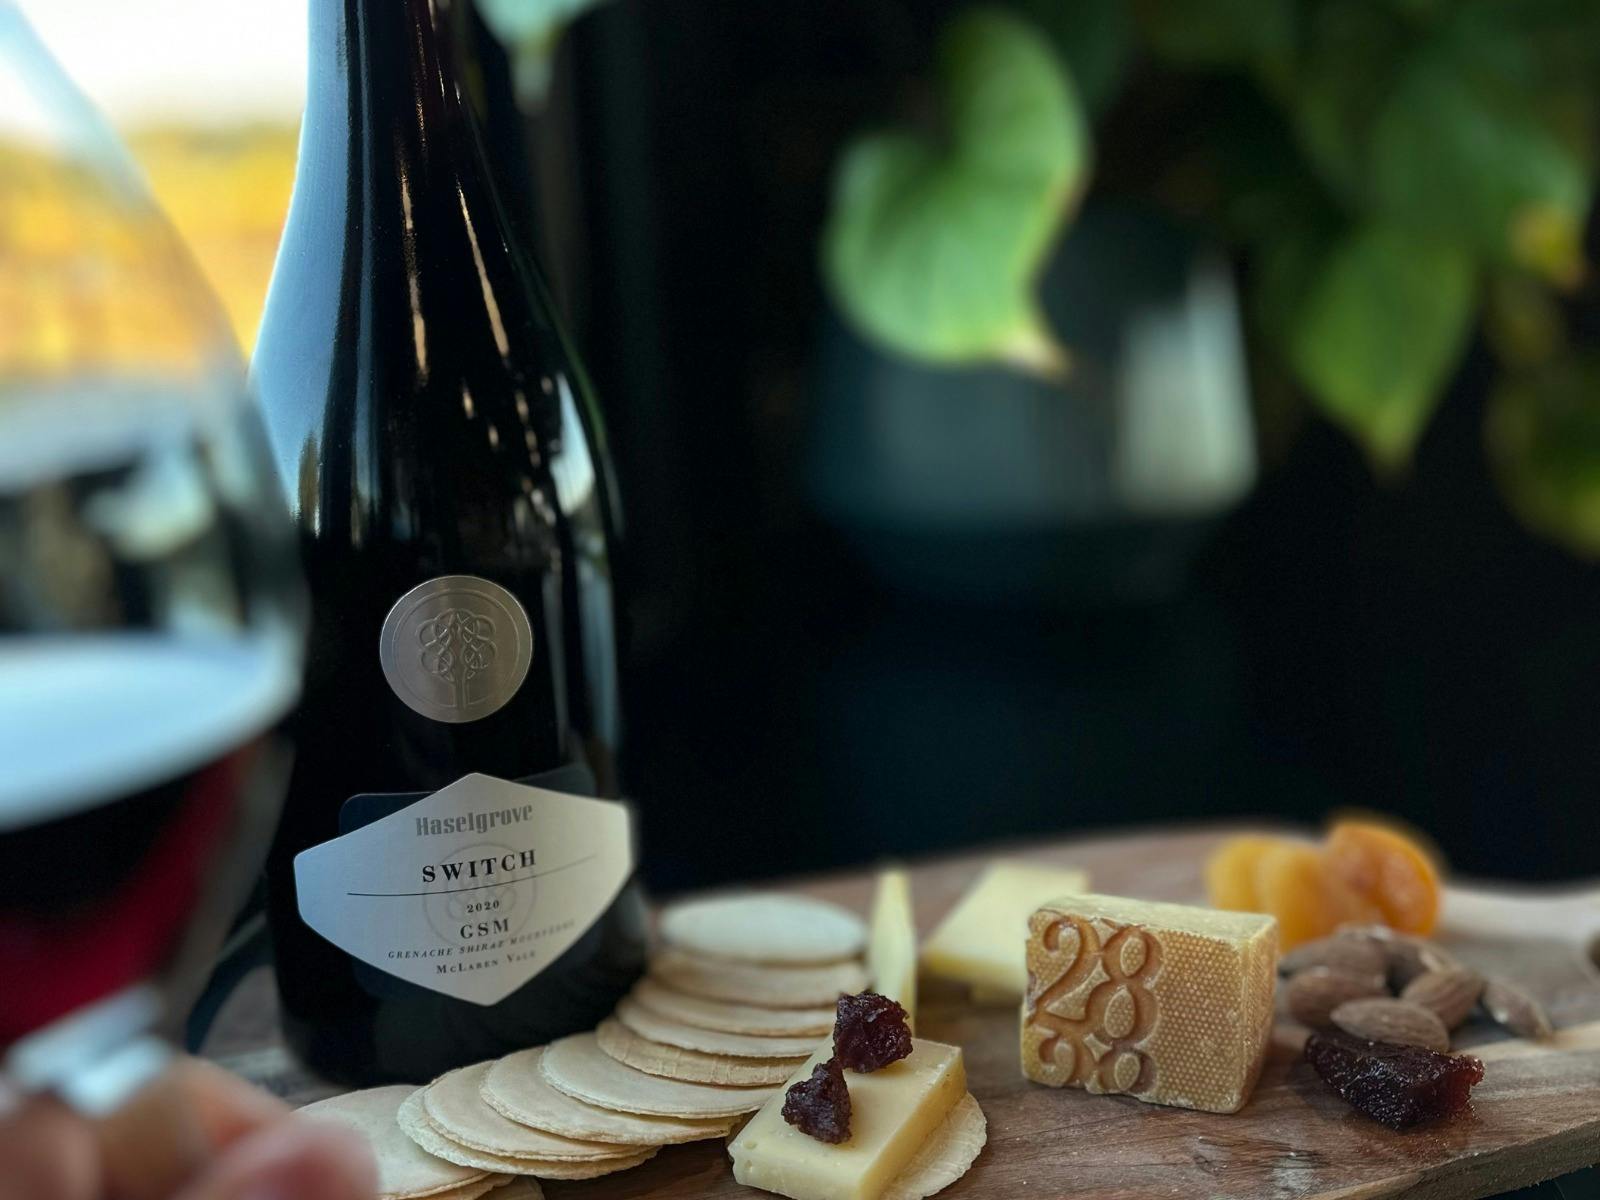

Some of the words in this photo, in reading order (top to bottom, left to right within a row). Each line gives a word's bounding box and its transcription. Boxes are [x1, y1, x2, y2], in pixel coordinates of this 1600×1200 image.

[416, 804, 533, 836] Haselgrove
[422, 849, 536, 883] SWITCH
[466, 900, 500, 913] 2020
[460, 918, 510, 939] GSM
[388, 947, 453, 959] GRENACHE
[1026, 916, 1164, 1049] 28
